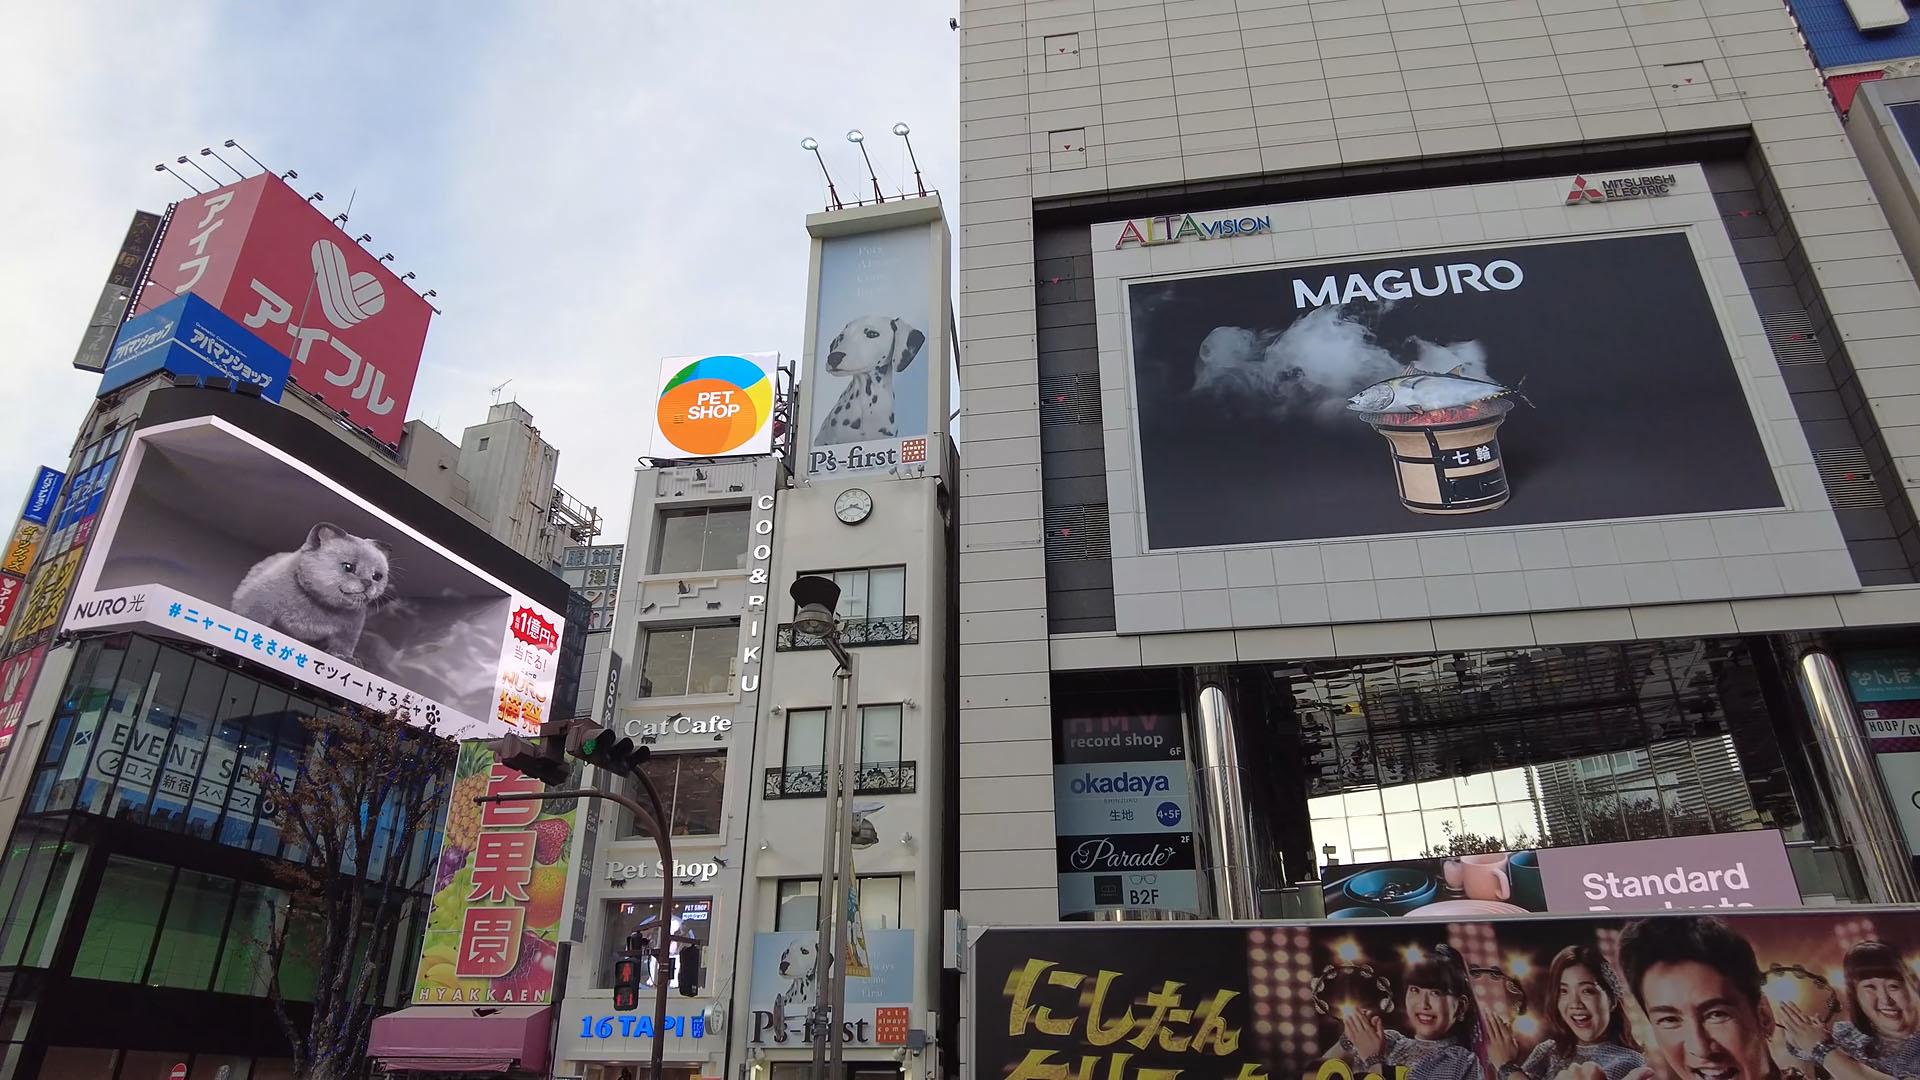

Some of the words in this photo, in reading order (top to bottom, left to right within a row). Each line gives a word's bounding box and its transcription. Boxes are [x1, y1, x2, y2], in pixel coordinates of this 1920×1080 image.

[1602, 174, 1676, 189] MITSUBISHI
[1606, 185, 1670, 199] ELECTRIC
[1292, 260, 1524, 308] MAGURO
[112, 321, 174, 361] アパマンショップ
[243, 278, 395, 415] アイフル
[190, 328, 273, 388] アパマンショップ
[697, 390, 734, 406] PET
[687, 404, 740, 420] SHOP
[1452, 445, 1492, 465] 七輪
[1851, 666, 1920, 686] なんぼ
[624, 718, 670, 737] Cat
[673, 715, 732, 735] Cafe
[111, 723, 202, 770] EVENT
[1070, 734, 1121, 748] record
[1125, 732, 1164, 748] shop
[1169, 747, 1182, 756] 6F
[219, 757, 293, 791] SPE
[1070, 771, 1170, 796] okadaya
[1109, 809, 1134, 822] 生地
[1180, 835, 1190, 844] 2F
[1070, 837, 1173, 870] Parade
[455, 753, 546, 978] 百果園
[604, 860, 648, 880] Pet
[655, 859, 718, 882] Shop
[1582, 863, 1750, 900] Standard
[1130, 890, 1159, 905] B2F
[419, 987, 547, 1002] HYAKKAEN
[878, 1009, 907, 1017] Pets
[1008, 958, 1242, 1056] にしたん
[878, 1017, 907, 1026] always
[878, 1033, 907, 1041] first
